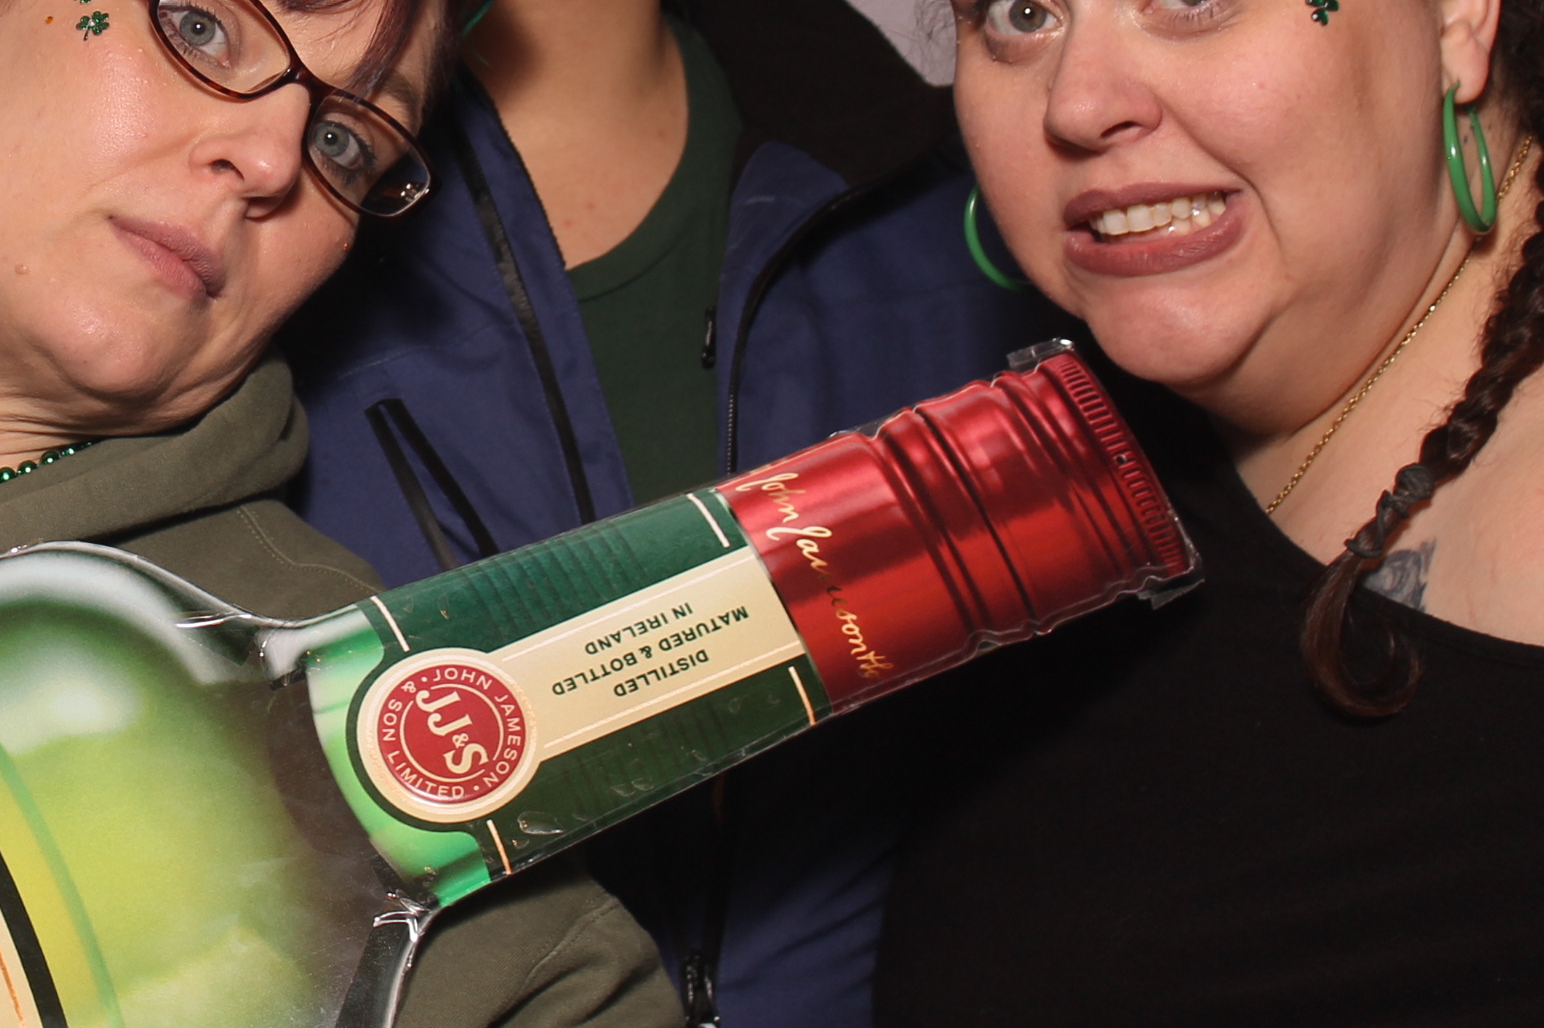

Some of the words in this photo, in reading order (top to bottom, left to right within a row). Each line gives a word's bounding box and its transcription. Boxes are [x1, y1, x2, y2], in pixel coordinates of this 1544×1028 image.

[736, 472, 805, 523] John
[585, 612, 670, 655] IRELAND
[658, 606, 749, 652] MATURED
[672, 602, 694, 620] IN
[552, 651, 638, 696] BOTTLED
[613, 648, 710, 697] DISTILLED
[638, 645, 653, 659] &
[401, 680, 417, 694] &
[382, 698, 403, 742] SON
[432, 667, 493, 690] JOHN
[482, 693, 522, 788] JAMESON
[388, 750, 465, 799] LIMITED
